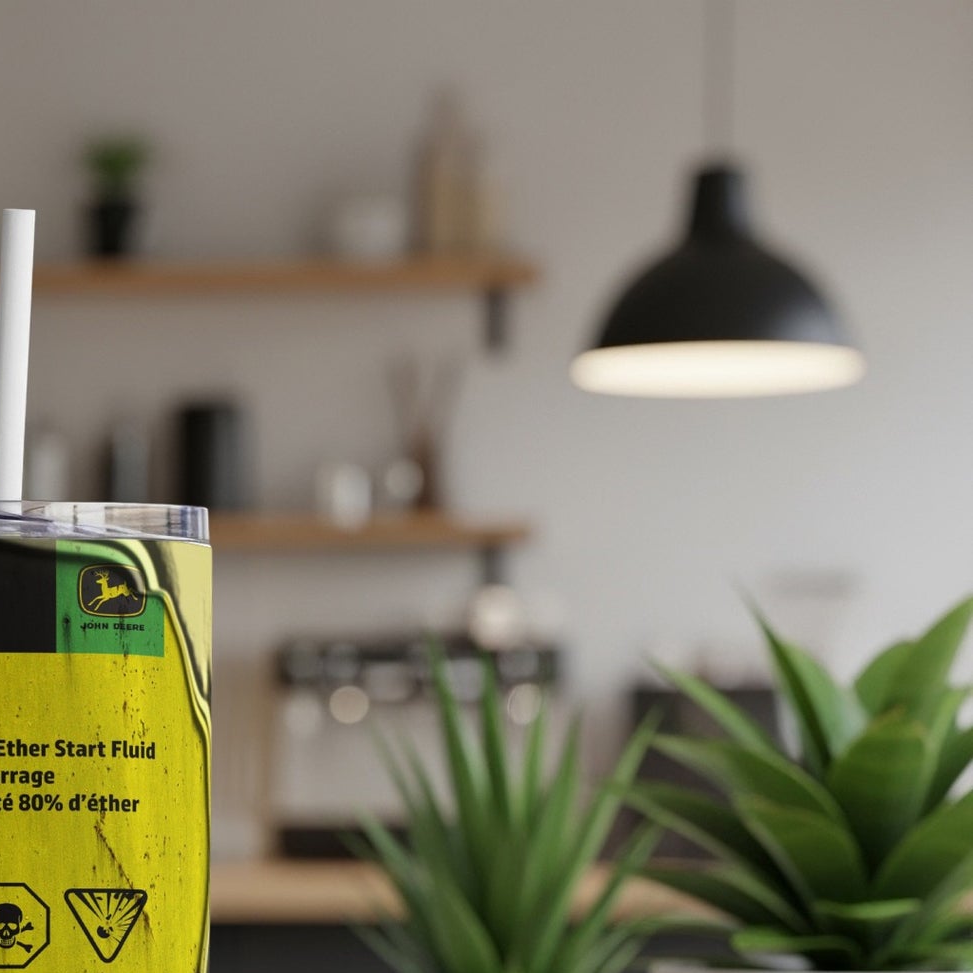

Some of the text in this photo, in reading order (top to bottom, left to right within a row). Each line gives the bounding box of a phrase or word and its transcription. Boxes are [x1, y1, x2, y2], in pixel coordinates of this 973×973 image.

[81, 622, 145, 631] JOHN DEERE
[55, 740, 106, 757] Start
[111, 741, 156, 759] Fluid
[19, 794, 63, 812] 80%
